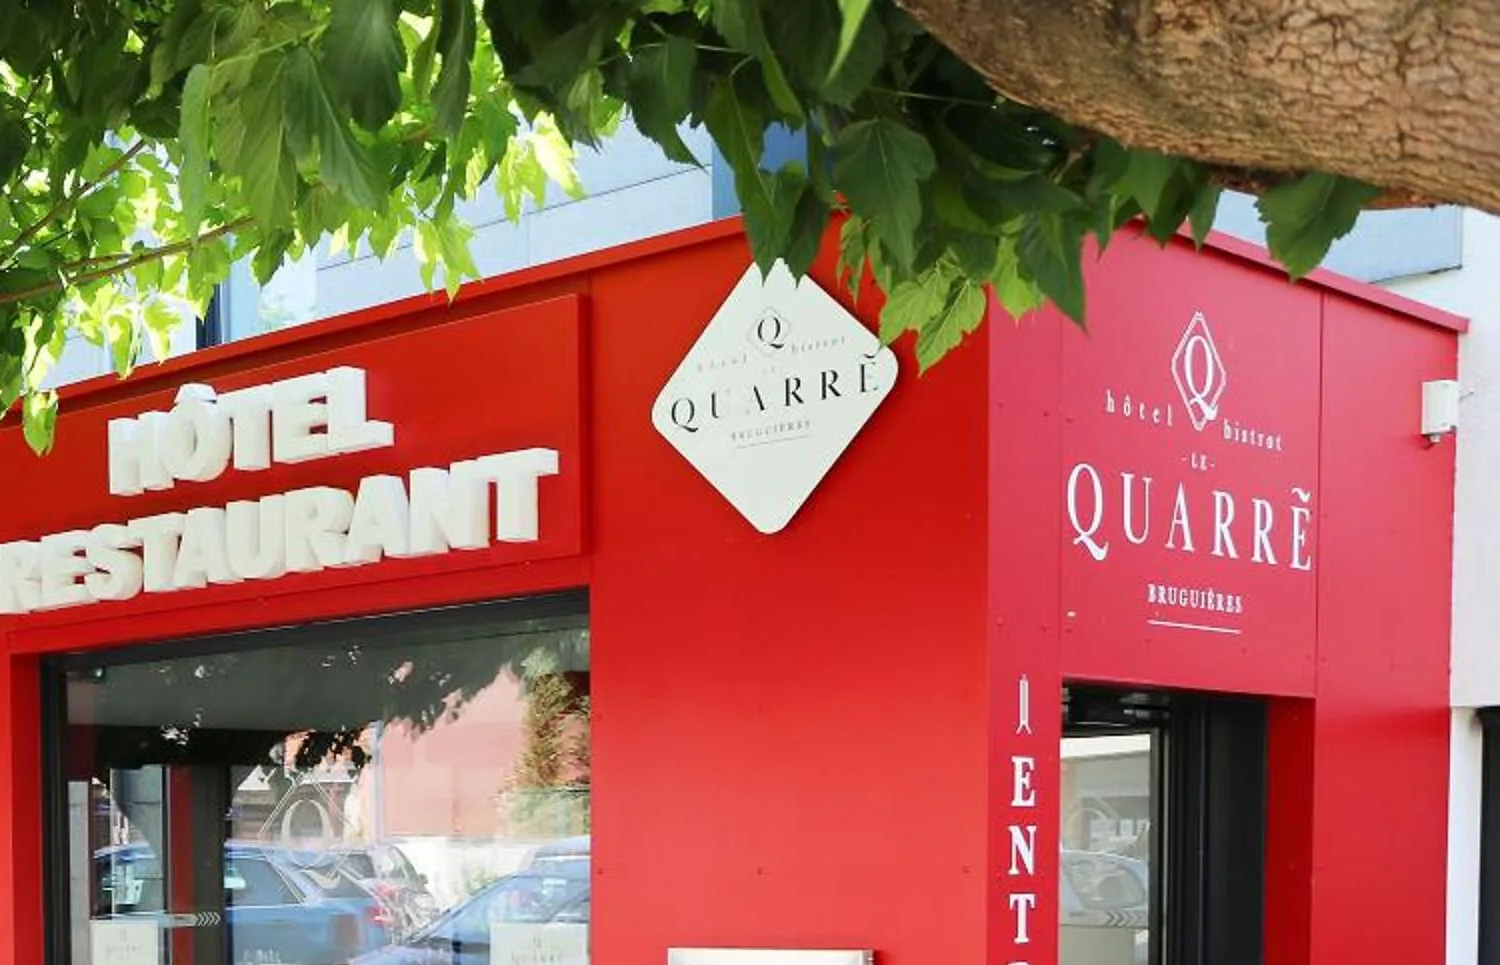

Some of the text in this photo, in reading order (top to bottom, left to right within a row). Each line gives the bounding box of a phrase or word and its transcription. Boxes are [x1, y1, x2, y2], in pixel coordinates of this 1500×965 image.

[757, 316, 785, 349] Q
[1184, 335, 1218, 421] Q
[108, 366, 394, 496] HÔTEL
[1106, 389, 1282, 451] hôtel bistrot
